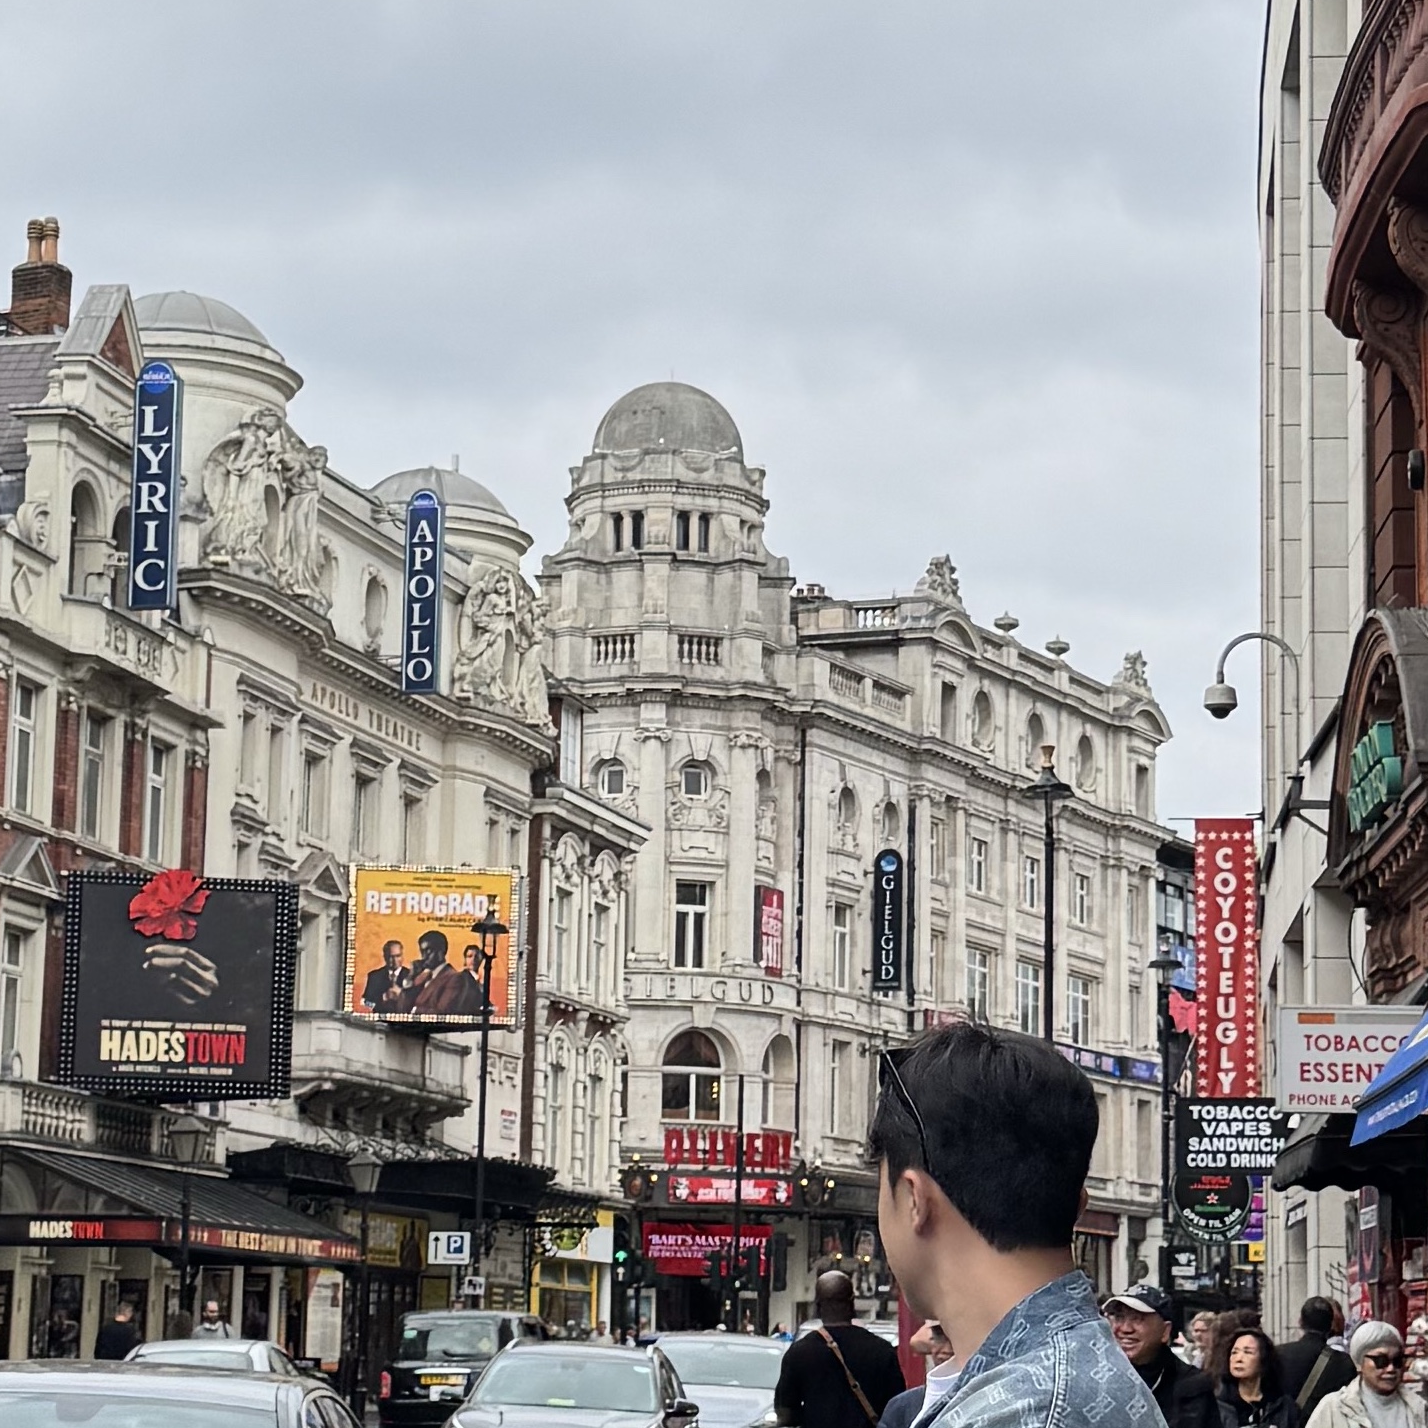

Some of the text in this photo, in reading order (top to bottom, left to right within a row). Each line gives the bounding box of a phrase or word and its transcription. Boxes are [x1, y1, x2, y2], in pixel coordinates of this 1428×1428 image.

[134, 404, 172, 592] LYRIC
[406, 519, 435, 682] APOLLO
[311, 682, 421, 751] APOLLO THEATRE
[880, 874, 895, 981] GIELGUD
[99, 1028, 246, 1065] HADESTOWN
[1288, 1093, 1336, 1106] PHONE
[1201, 1121, 1272, 1136] VAPES
[1186, 1153, 1227, 1168] COLD
[29, 1220, 104, 1239] HADESTOWN
